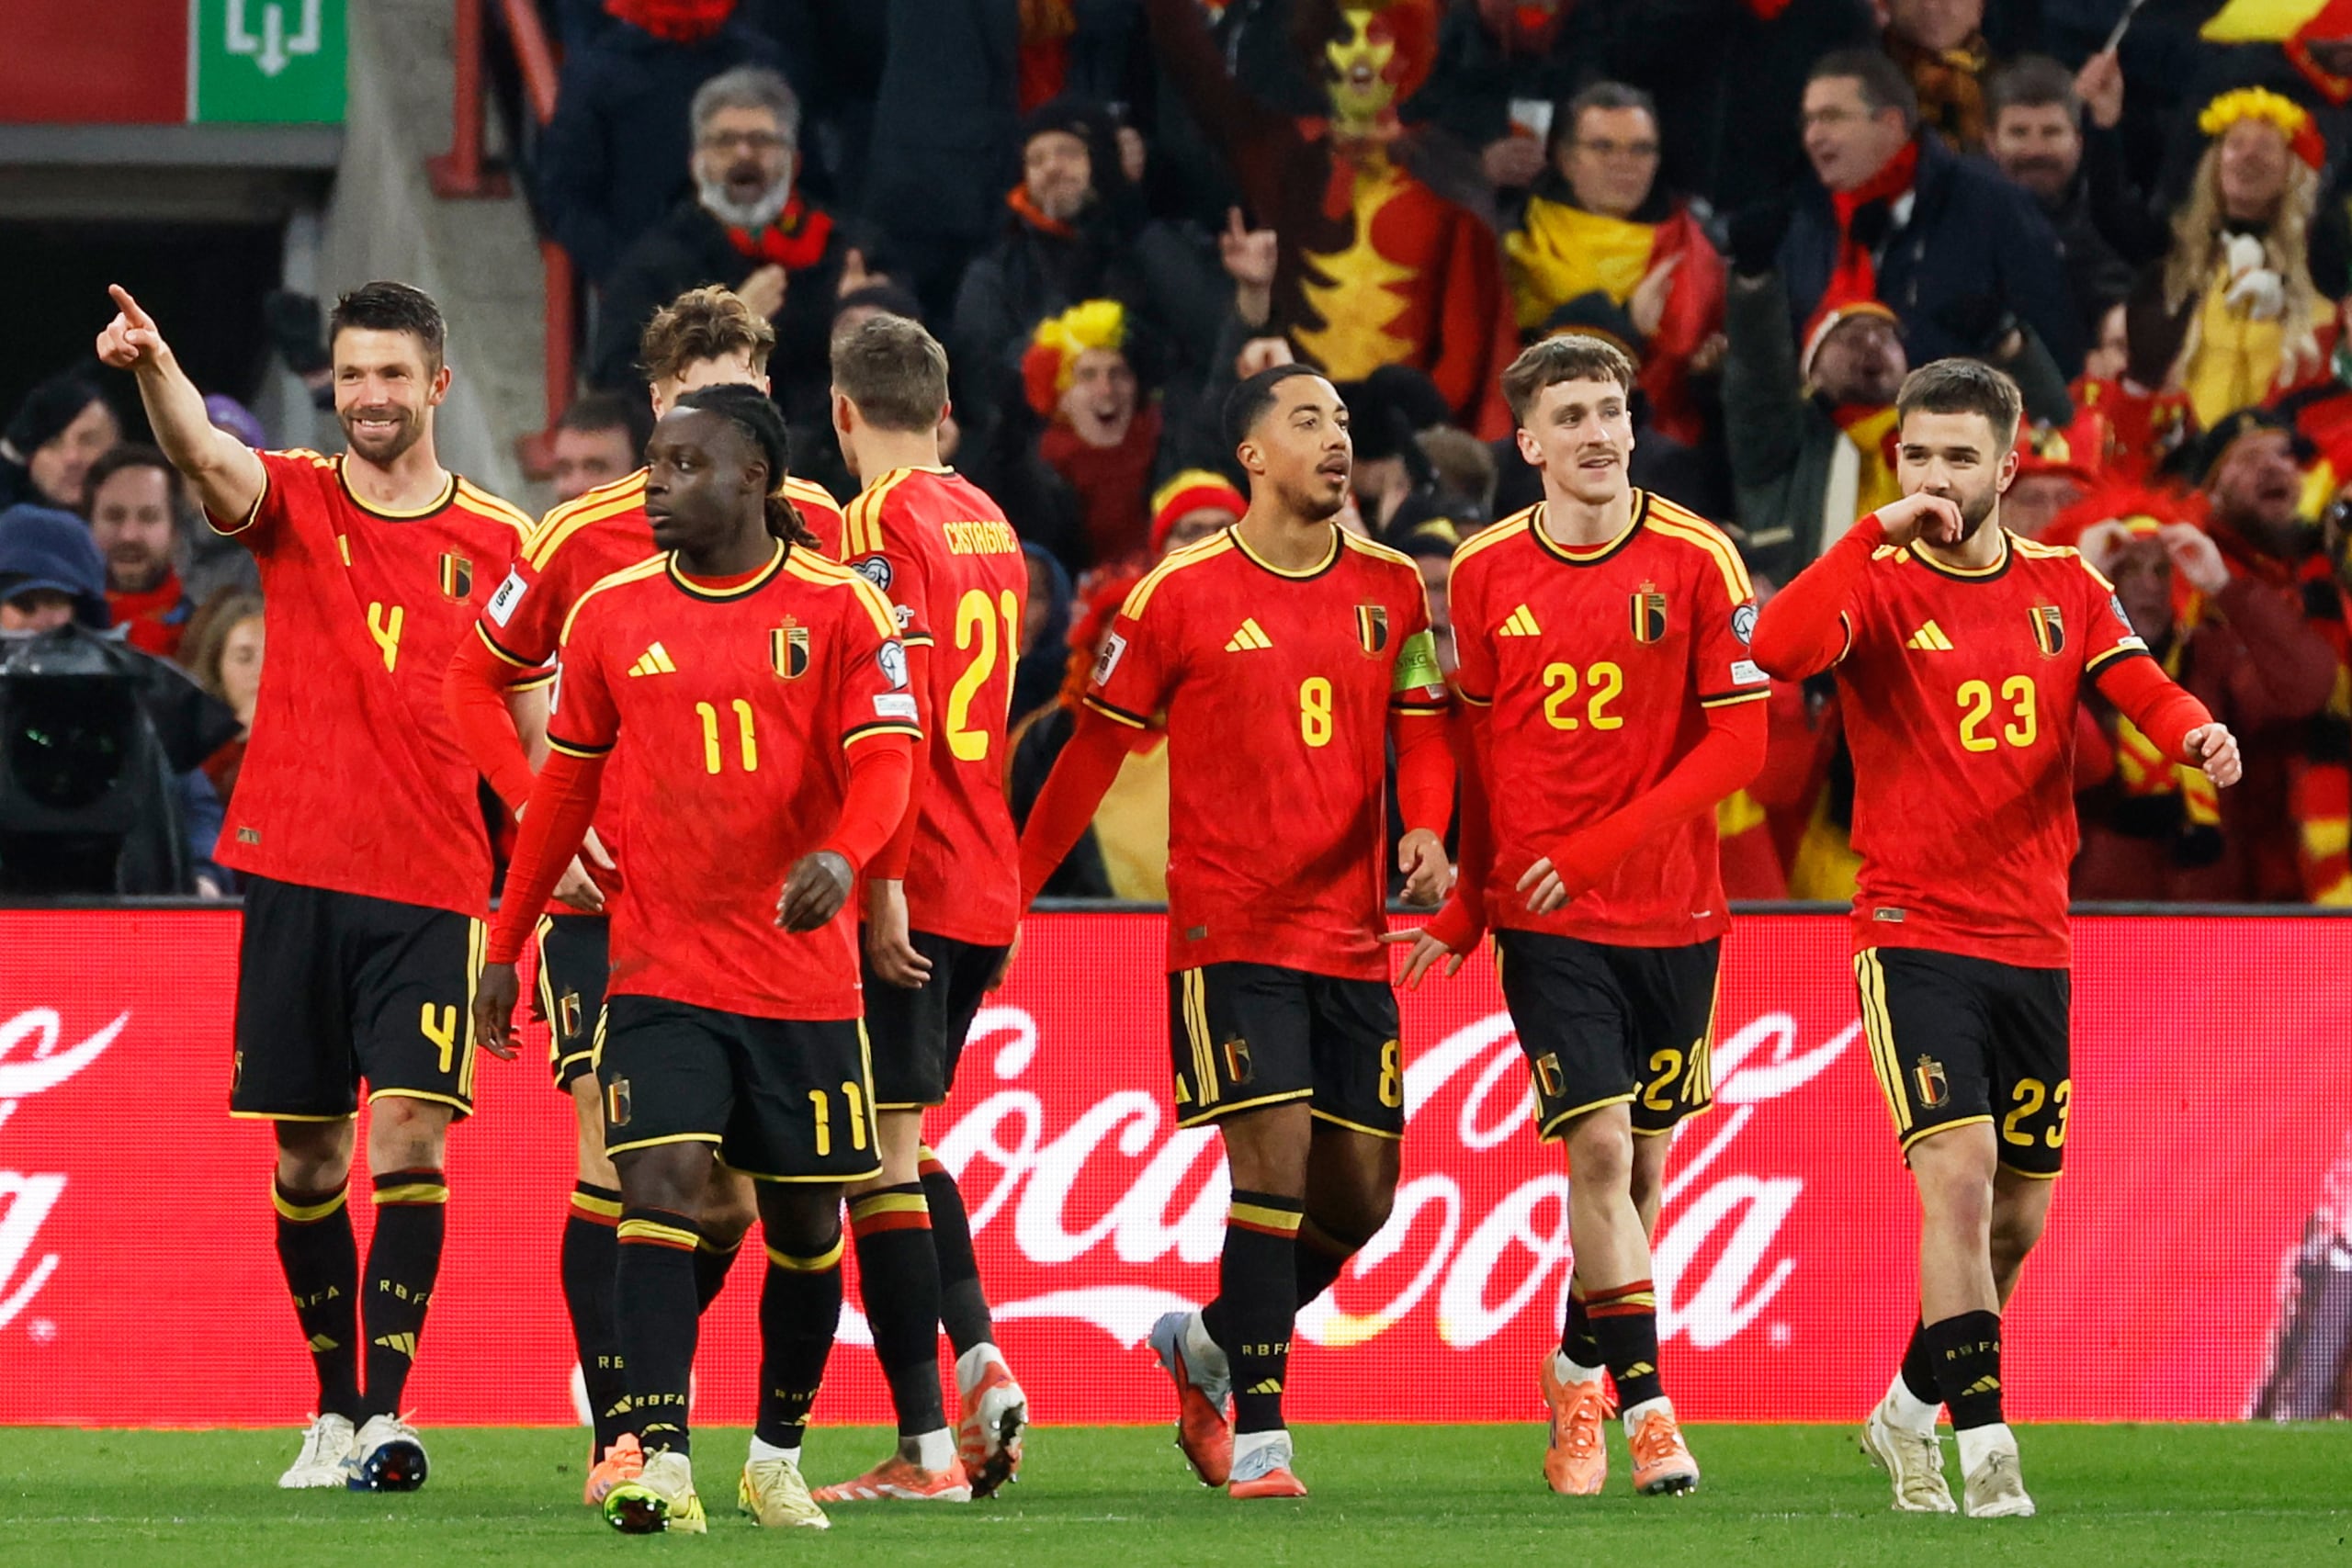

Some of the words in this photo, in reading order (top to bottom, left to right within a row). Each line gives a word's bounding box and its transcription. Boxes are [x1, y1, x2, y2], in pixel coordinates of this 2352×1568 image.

[943, 521, 1017, 555] CASTAGNE
[368, 602, 404, 673] 4
[945, 589, 1020, 761] 21
[1543, 661, 1623, 730] 22
[695, 699, 758, 774] 11
[1300, 676, 1332, 747] 8
[1957, 674, 2037, 752] 23
[421, 1001, 457, 1074] 4
[1379, 1039, 1403, 1108] 8
[808, 1081, 866, 1156] 11
[2003, 1077, 2071, 1148] 23
[293, 1286, 340, 1308] BFA
[597, 1355, 625, 1370] RB
[635, 1393, 685, 1408] RBFA
